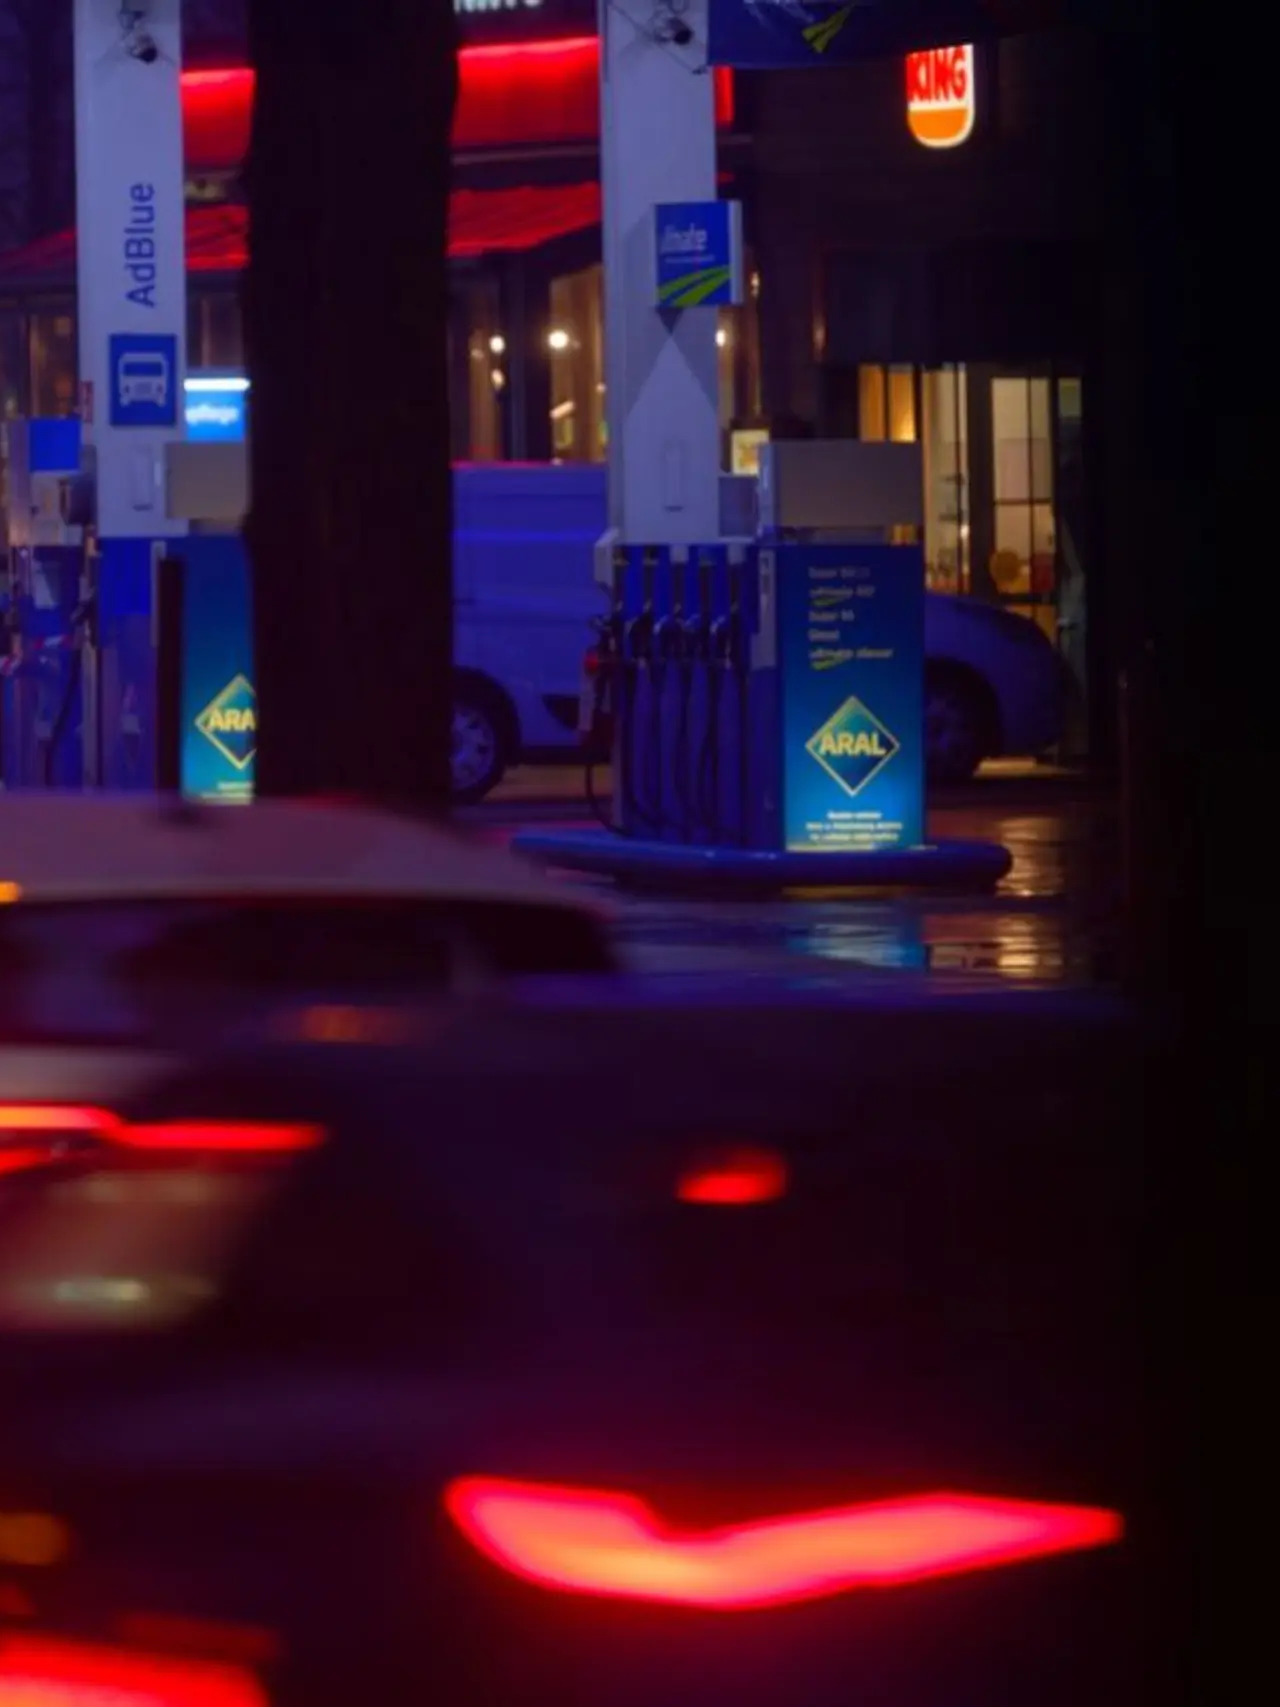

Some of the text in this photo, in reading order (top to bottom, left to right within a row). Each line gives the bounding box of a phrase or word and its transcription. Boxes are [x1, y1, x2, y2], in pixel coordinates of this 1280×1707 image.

[124, 182, 158, 309] AdBlue
[209, 708, 257, 732] ARA
[817, 732, 887, 756] ARAL
